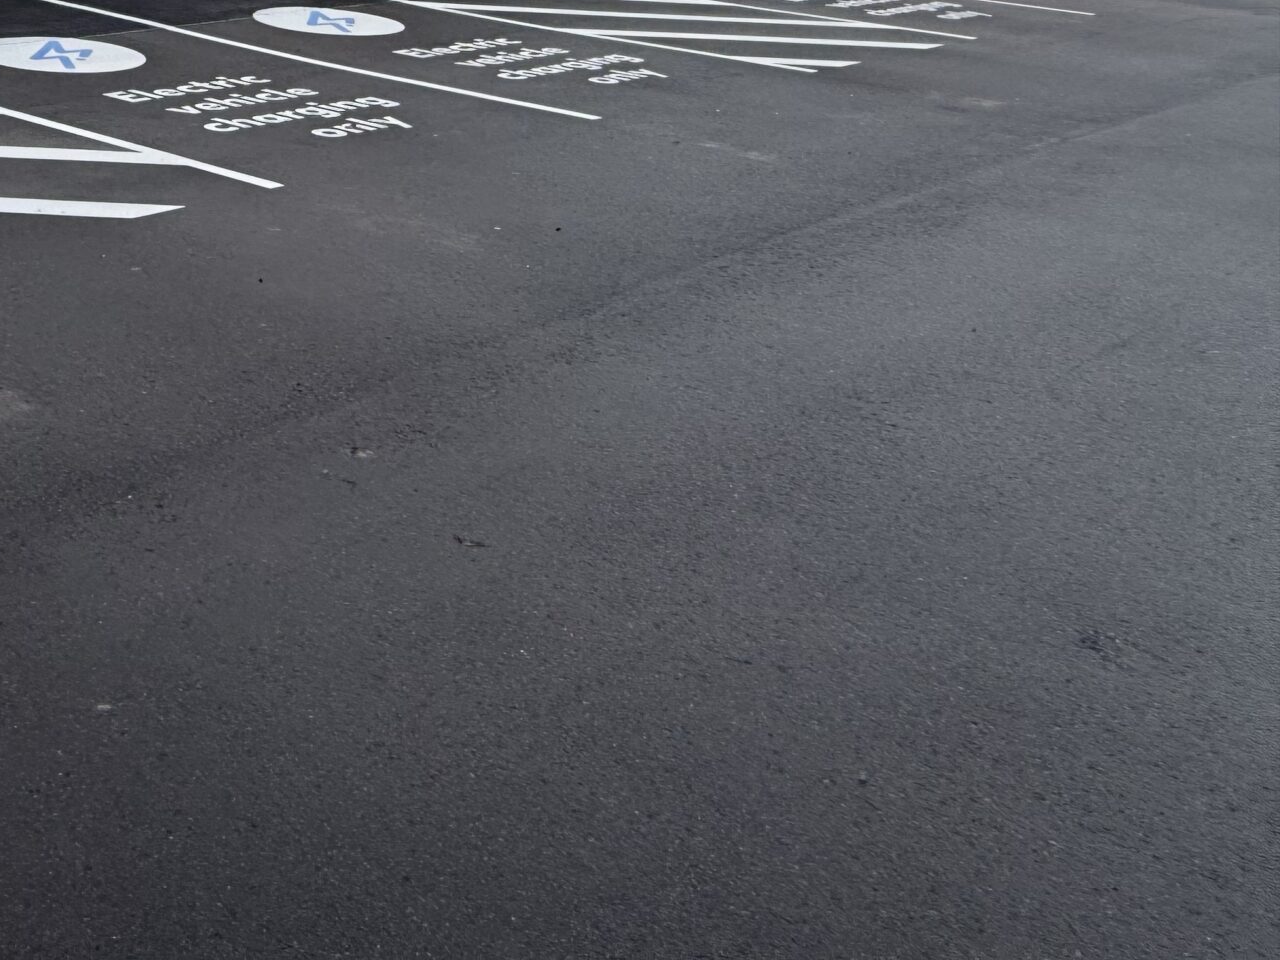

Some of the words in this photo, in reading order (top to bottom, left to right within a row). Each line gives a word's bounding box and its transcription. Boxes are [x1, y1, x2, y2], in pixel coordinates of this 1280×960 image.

[102, 75, 272, 103] Electric
[165, 87, 320, 115] vehicle
[203, 96, 401, 132] charging
[311, 115, 413, 138] only
